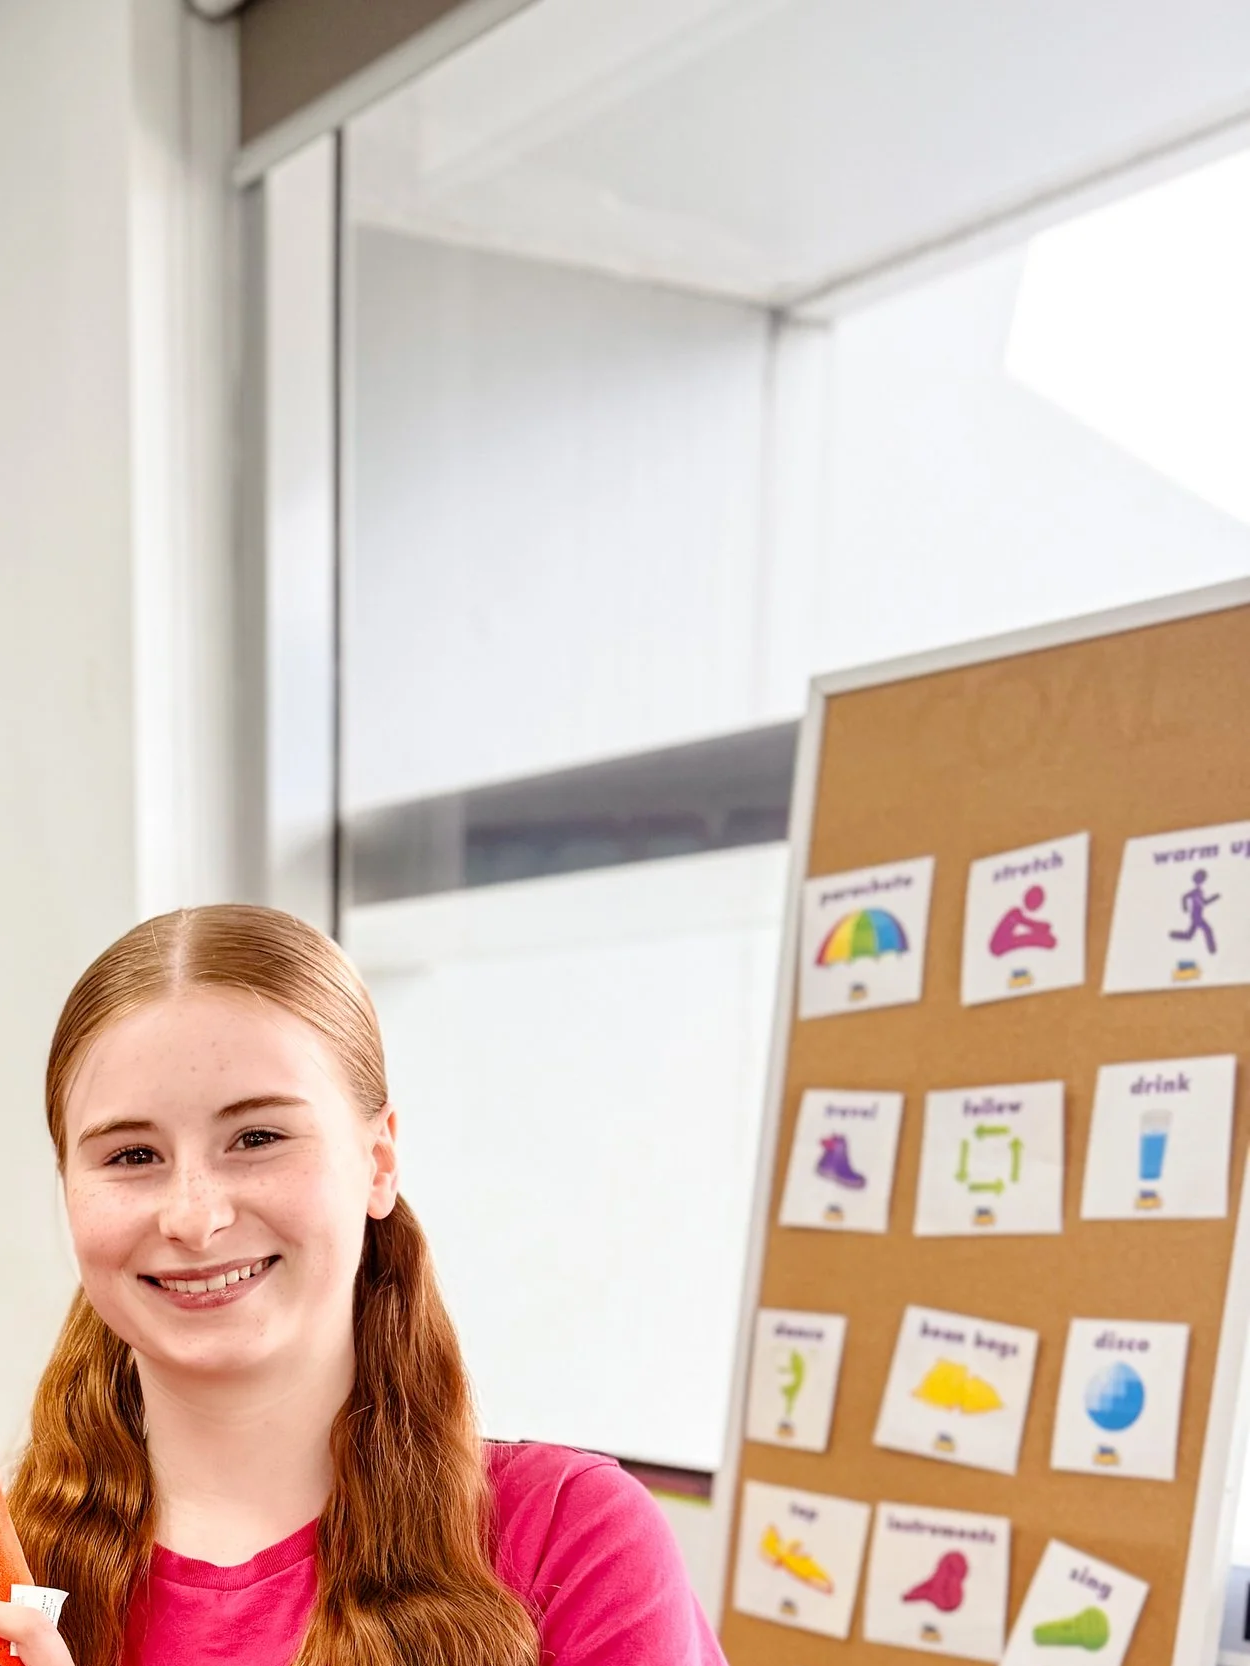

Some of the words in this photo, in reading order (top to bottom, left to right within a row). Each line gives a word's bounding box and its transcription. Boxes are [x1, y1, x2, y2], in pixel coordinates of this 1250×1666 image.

[992, 851, 1064, 882] stretch
[1153, 845, 1220, 865] warm
[819, 874, 914, 907] parachute
[1130, 1073, 1190, 1096] drink
[962, 1097, 1023, 1118] follow
[773, 1322, 825, 1341] dance
[919, 1321, 966, 1344] bean
[973, 1329, 1019, 1358] bags
[1093, 1331, 1151, 1353] disco
[887, 1515, 997, 1544] instruments
[1068, 1566, 1113, 1601] sing
